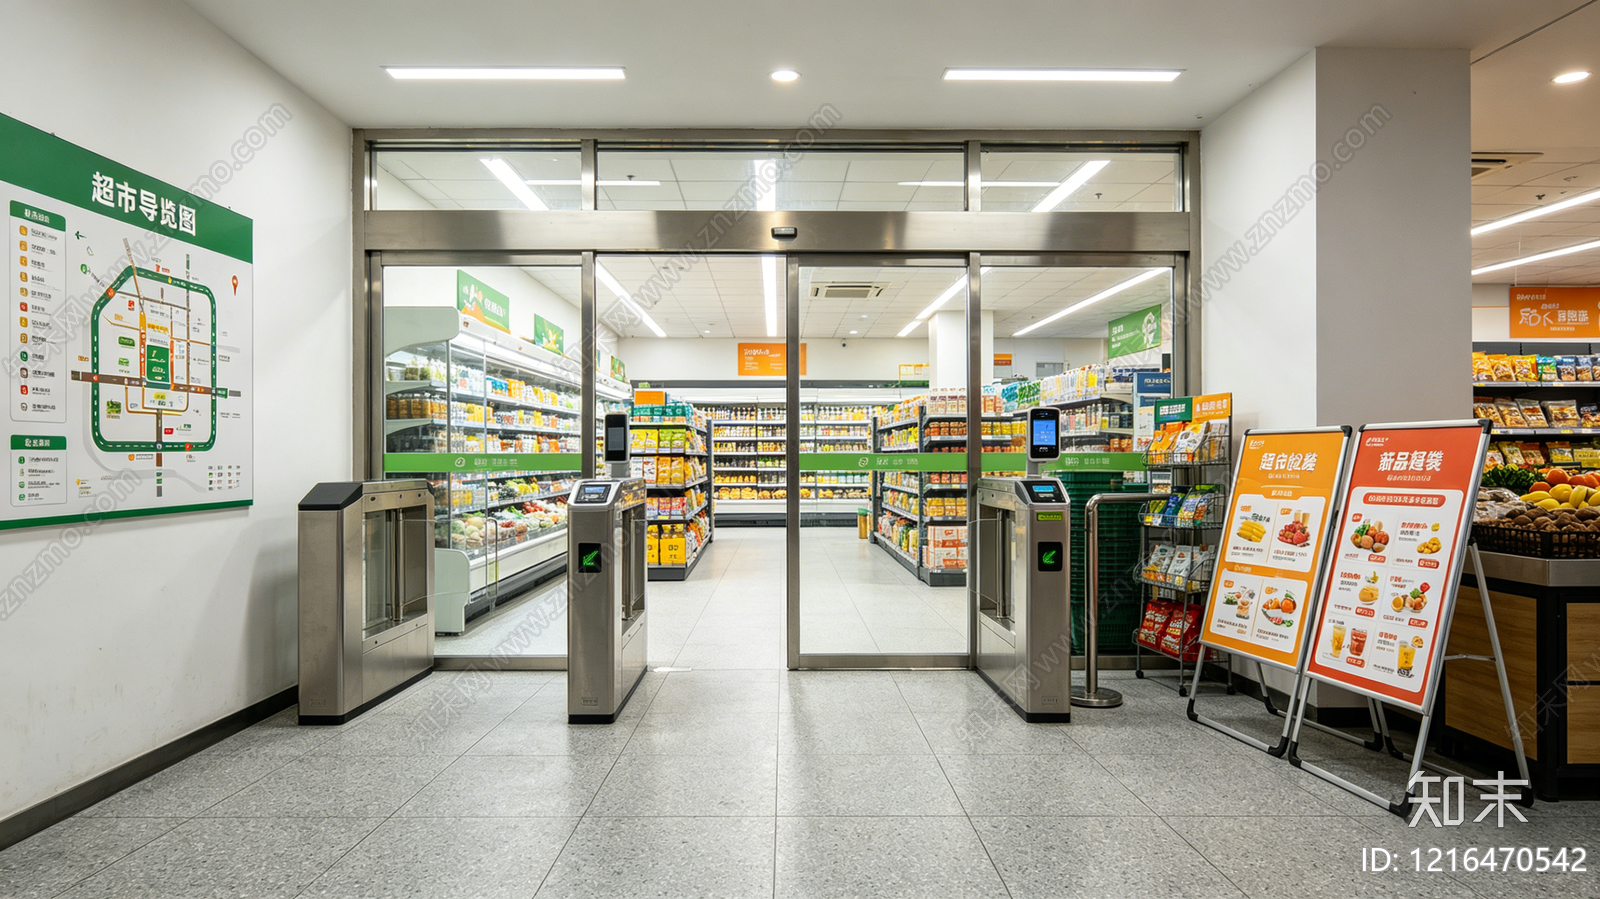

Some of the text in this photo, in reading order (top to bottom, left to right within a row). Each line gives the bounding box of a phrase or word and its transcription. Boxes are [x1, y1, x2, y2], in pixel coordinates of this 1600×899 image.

[92, 171, 196, 236] 超市导览图
